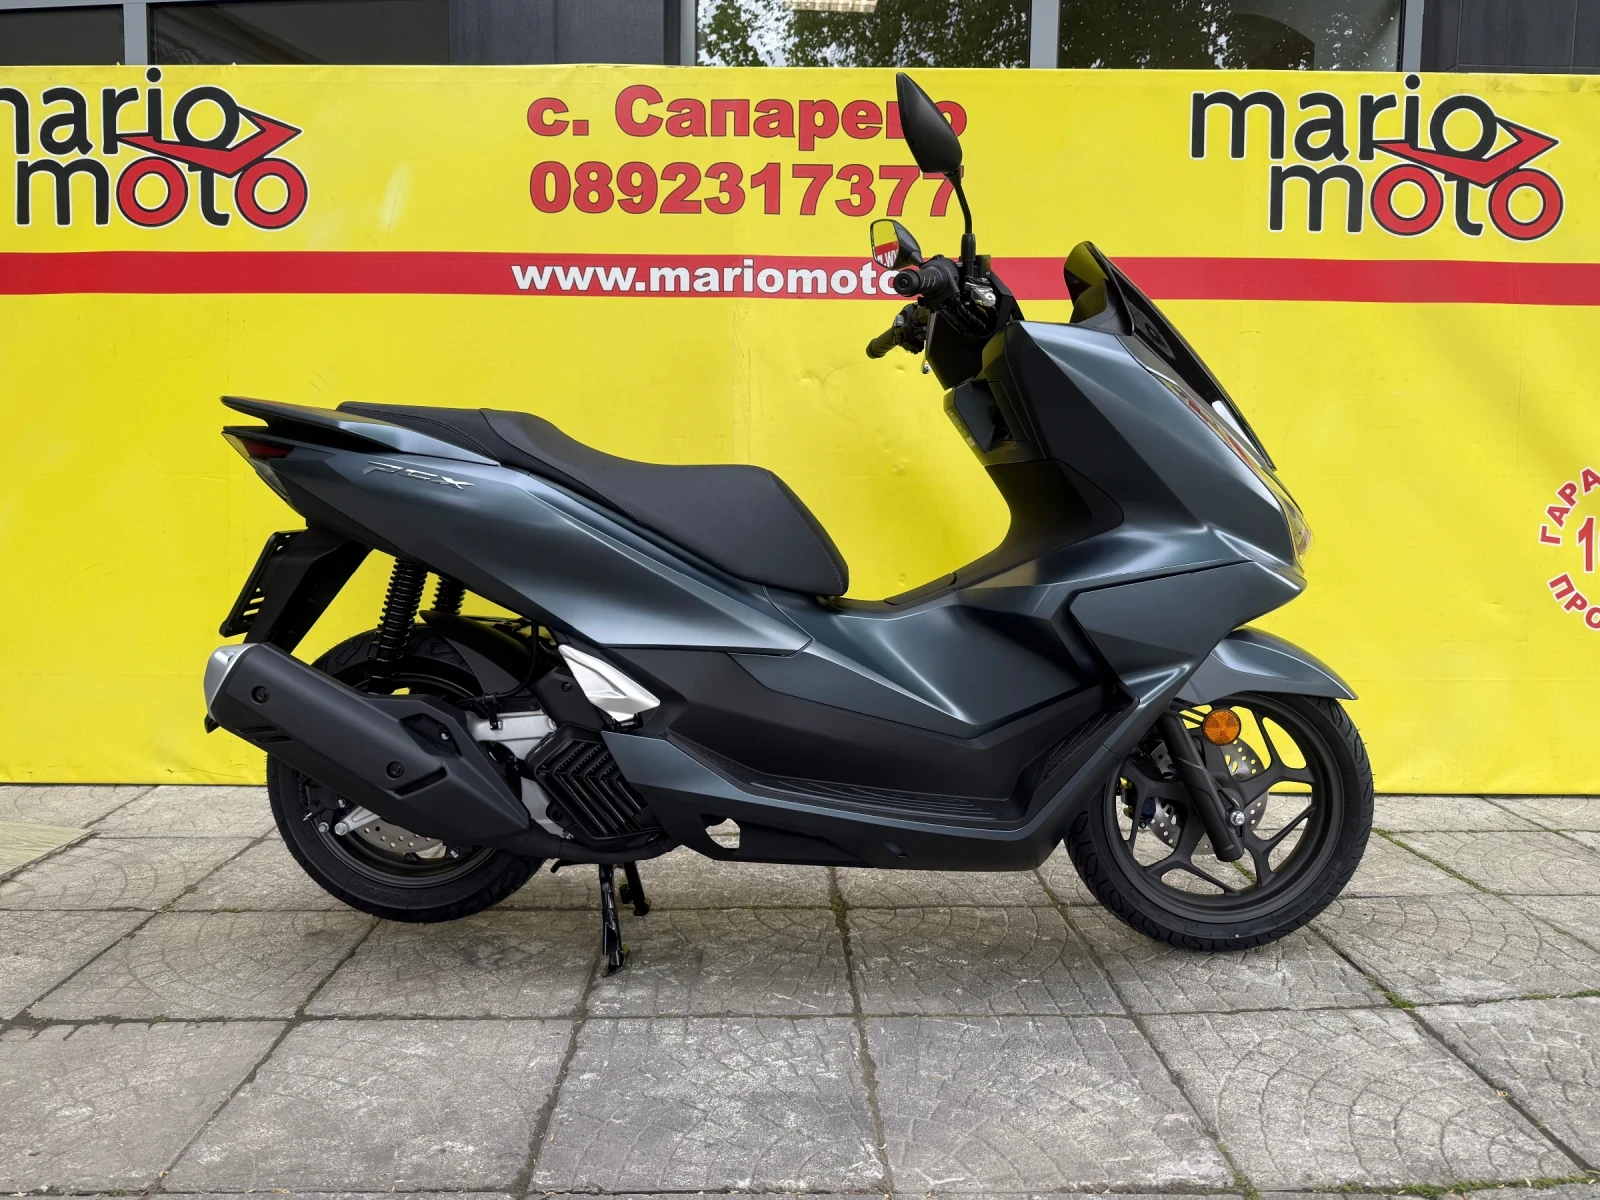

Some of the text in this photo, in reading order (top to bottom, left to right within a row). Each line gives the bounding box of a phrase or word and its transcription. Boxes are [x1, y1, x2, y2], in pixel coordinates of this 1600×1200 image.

[1190, 73, 1497, 161] mario
[15, 155, 308, 229] moto
[529, 161, 965, 217] 0892317377
[1268, 163, 1564, 241] moto
[1578, 517, 1600, 572] 1
